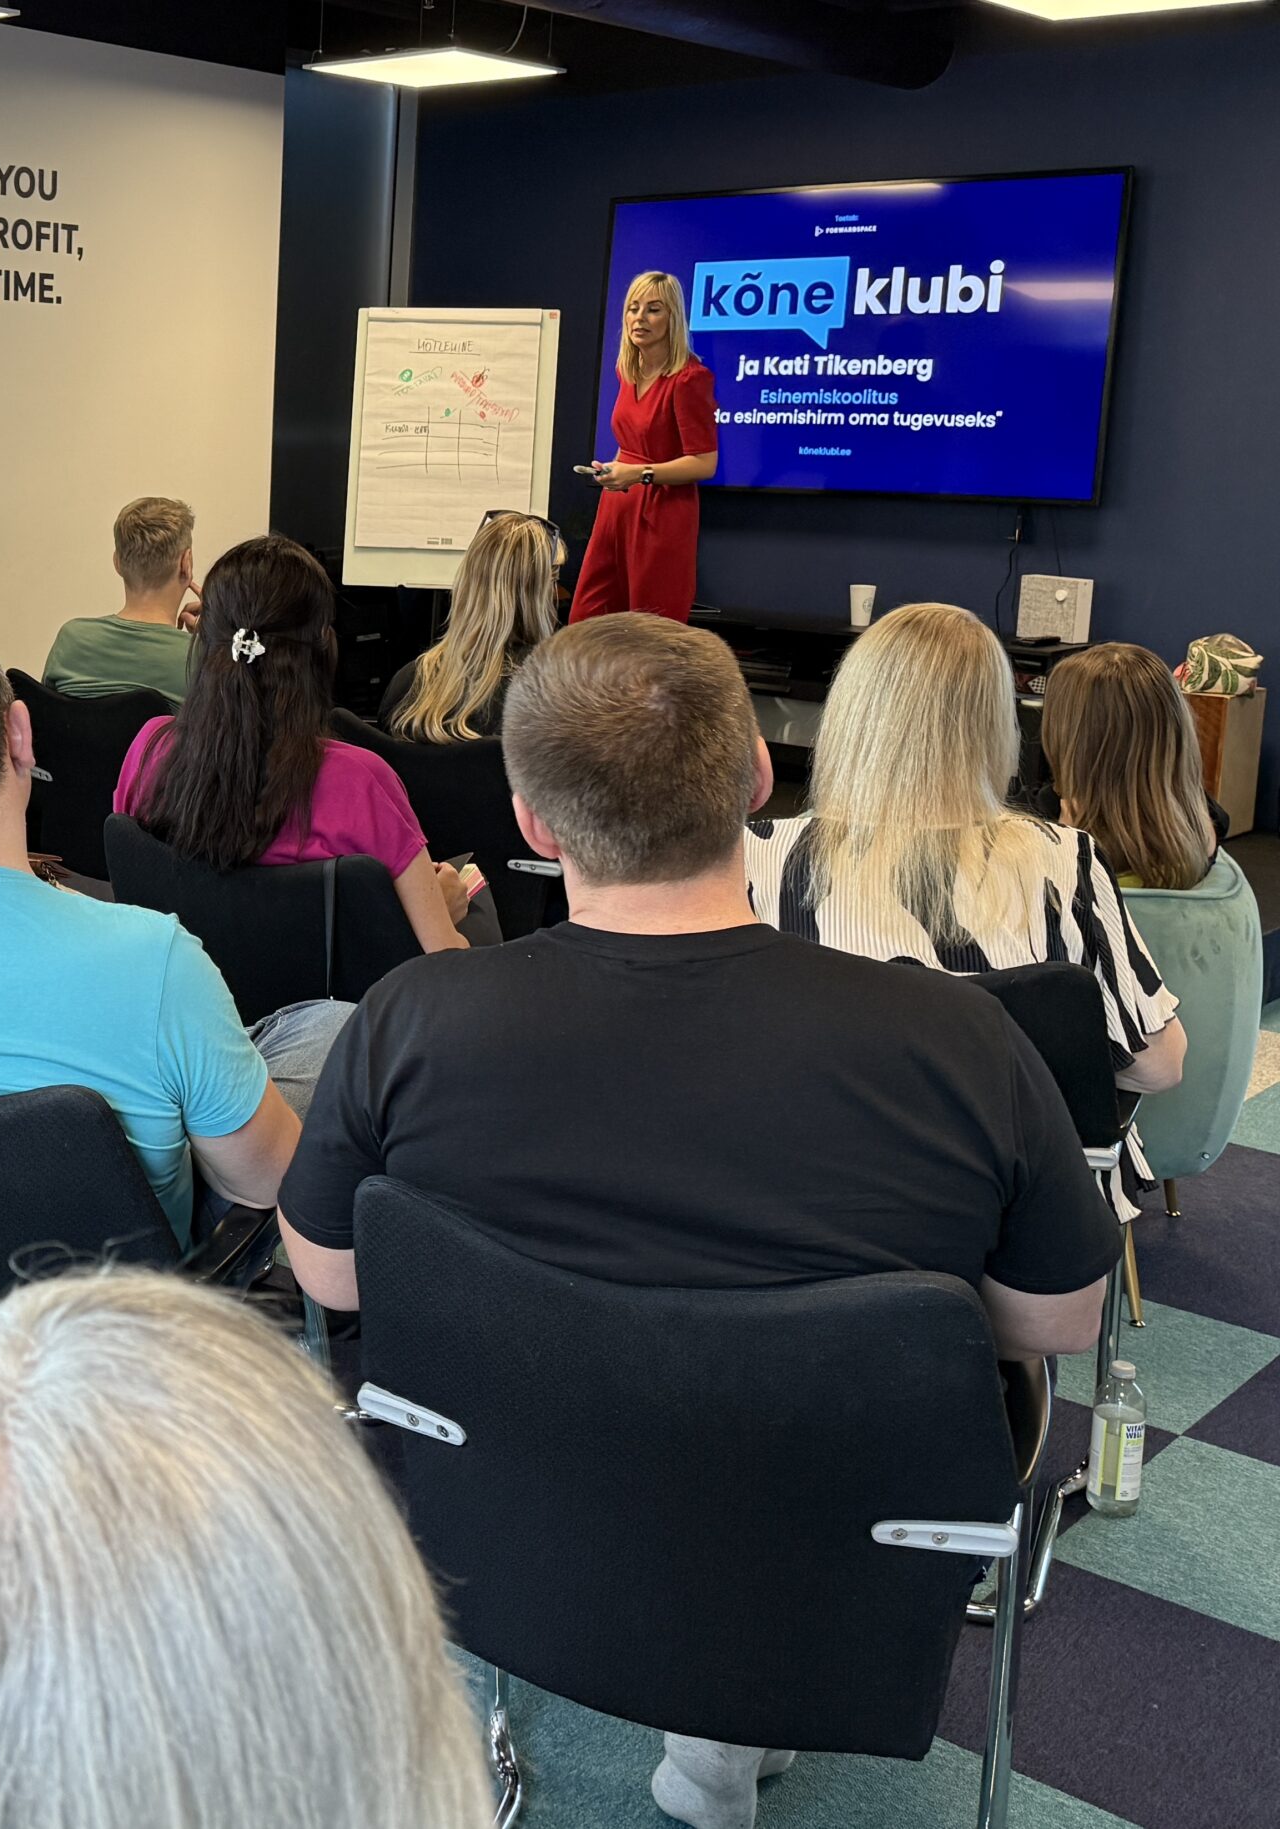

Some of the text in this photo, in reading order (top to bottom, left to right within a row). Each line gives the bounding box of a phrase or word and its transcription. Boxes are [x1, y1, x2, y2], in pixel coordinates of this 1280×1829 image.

[702, 260, 1005, 317] kõne klubi
[736, 354, 933, 382] ja Kati Tikenberg
[760, 389, 898, 405] Esinemiskoolitus
[734, 409, 844, 425] esinemishirm
[848, 413, 889, 426] oma
